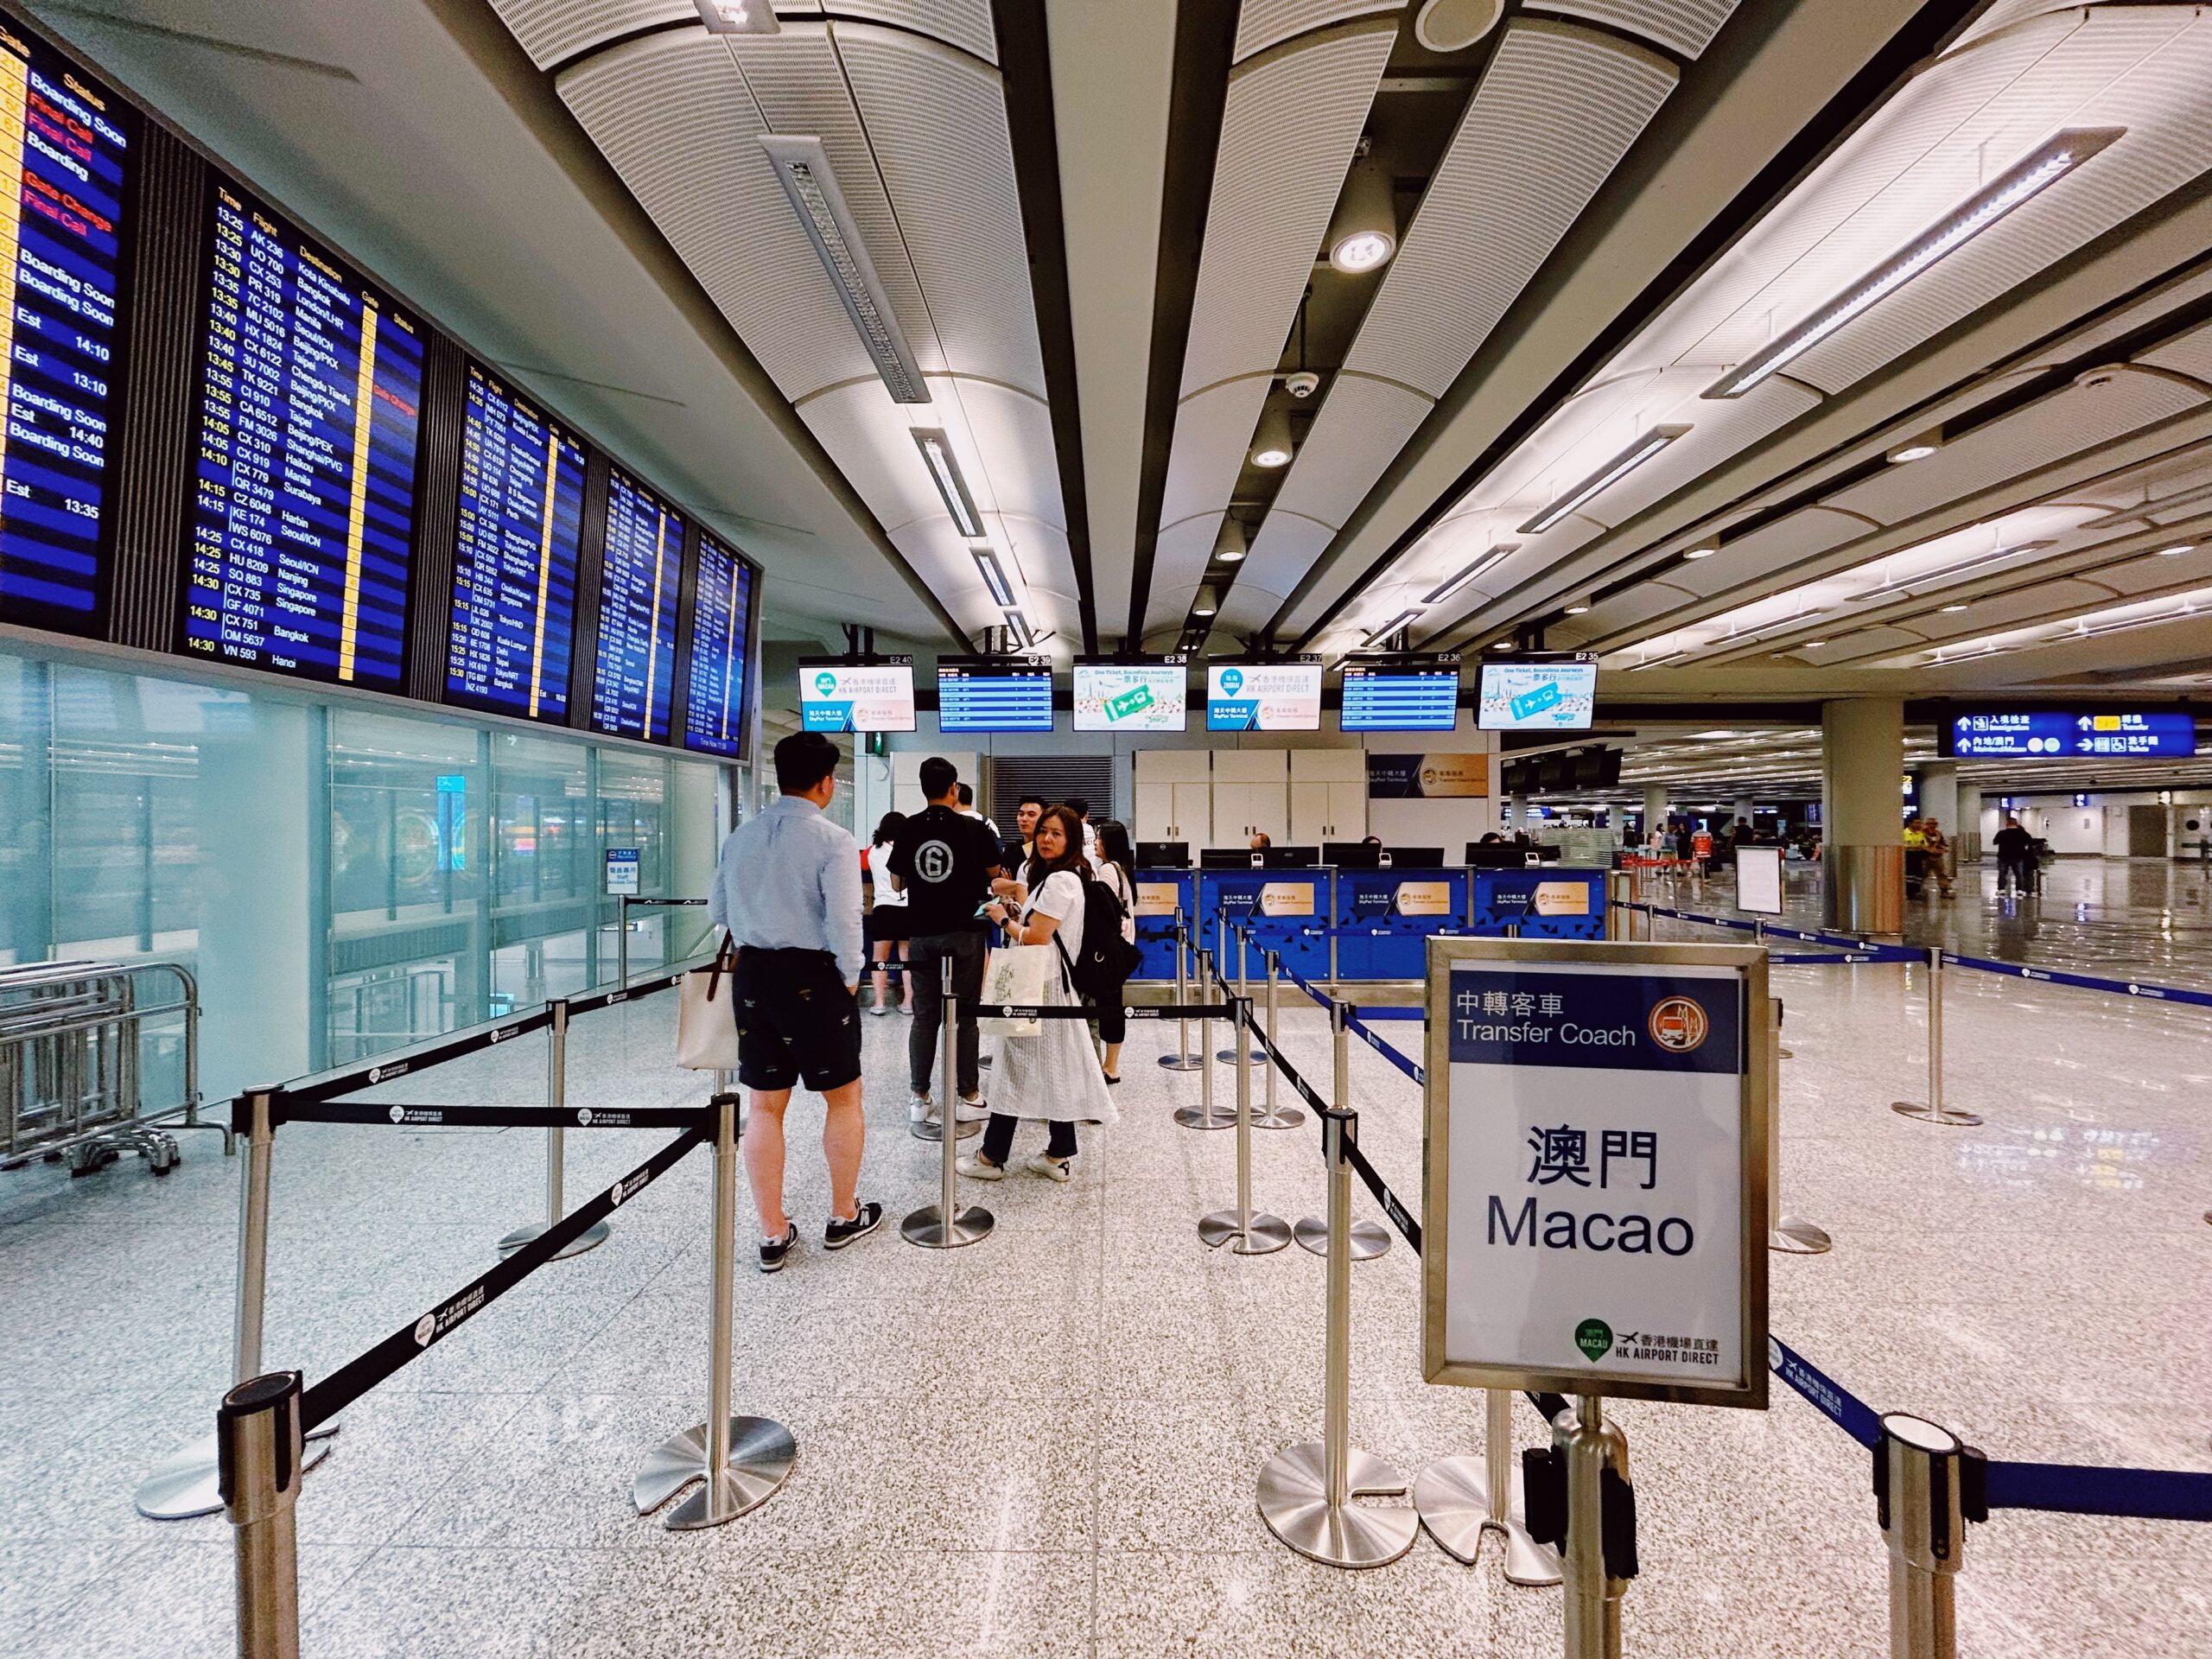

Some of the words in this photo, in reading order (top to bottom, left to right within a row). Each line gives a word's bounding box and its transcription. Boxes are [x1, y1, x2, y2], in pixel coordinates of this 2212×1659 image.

[29, 92, 66, 124] Final
[64, 118, 93, 143] Call
[30, 72, 92, 126] Boarding
[93, 117, 127, 149] Soon
[63, 73, 105, 111] Status
[26, 130, 88, 181] Boarding
[28, 110, 65, 143] Final
[63, 137, 92, 162] Call
[24, 170, 61, 200] Gate
[60, 194, 112, 232] Change
[20, 248, 81, 293] Boarding
[83, 283, 115, 308] Soon
[216, 222, 243, 247] 13:25
[250, 244, 266, 262] UO
[267, 256, 284, 275] 700
[297, 276, 331, 307] Bangkok
[218, 206, 244, 232] 13:25
[251, 230, 265, 247] AK
[266, 239, 283, 258] 236
[298, 262, 317, 283] Kota
[317, 275, 350, 305] Kinabalu
[218, 186, 242, 211] Time
[252, 212, 277, 237] Flight
[299, 245, 342, 283] Destination
[361, 290, 378, 308] Gate
[393, 313, 414, 334] Status
[215, 238, 242, 263] 13:30
[249, 260, 264, 277] CX
[264, 270, 282, 289] 253
[296, 290, 344, 330] London/LHR
[16, 306, 41, 329] Est
[75, 336, 109, 360] 14:10
[213, 270, 239, 294] 13:35
[247, 290, 261, 307] 7C
[261, 301, 283, 321] 2102
[294, 321, 334, 353] Seoul/ICN
[14, 345, 39, 366] Est
[73, 372, 107, 396] 13:10
[208, 335, 235, 357] 13:40
[242, 353, 257, 368] 3U
[257, 360, 280, 382] 7002
[290, 378, 336, 412] Beijing/PKX
[10, 402, 35, 423] Est
[69, 426, 104, 448] 14:40
[12, 383, 73, 421] Boarding
[74, 409, 106, 432] Soon
[202, 415, 230, 435] 14:05
[237, 430, 252, 446] CX
[253, 437, 271, 454] 310
[285, 452, 314, 474] Haikou
[204, 399, 231, 420] 13:55
[238, 415, 254, 430] FM
[255, 423, 277, 442] 3026
[286, 438, 342, 472] Shanghai/PVG
[6, 479, 30, 498] Est
[64, 498, 99, 518] 13:35
[200, 447, 227, 466] 14:10
[236, 461, 251, 476] CX
[251, 467, 269, 483] 779
[283, 481, 321, 505] Surabaya
[234, 476, 251, 492] QR
[251, 483, 274, 500] 3479
[197, 494, 225, 512] 14:15
[232, 506, 247, 521] KE
[249, 513, 265, 527] 174
[281, 524, 321, 548] Seoul/ICN
[194, 557, 220, 575] 14:25
[228, 567, 244, 582] SQ
[245, 573, 262, 587] 883
[276, 582, 317, 602] Singapore
[455, 575, 470, 588] 15:15
[188, 637, 214, 652] 14:30
[223, 644, 238, 657] VN
[239, 647, 257, 660] 593
[271, 654, 296, 668] Hanoi
[1287, 683, 1309, 692] DIRECT
[1457, 989, 1564, 1017] 中轉客車
[1457, 1019, 1553, 1044] Transfer
[1560, 1023, 1636, 1046] Coach
[1527, 1123, 1657, 1190] 澳門
[1488, 1195, 1694, 1257] Macao
[1580, 1338, 1608, 1349] MACAU
[1616, 1346, 1630, 1358] HK
[1633, 1349, 1678, 1362] AIRPORT
[1681, 1351, 1719, 1364] DIRECT
